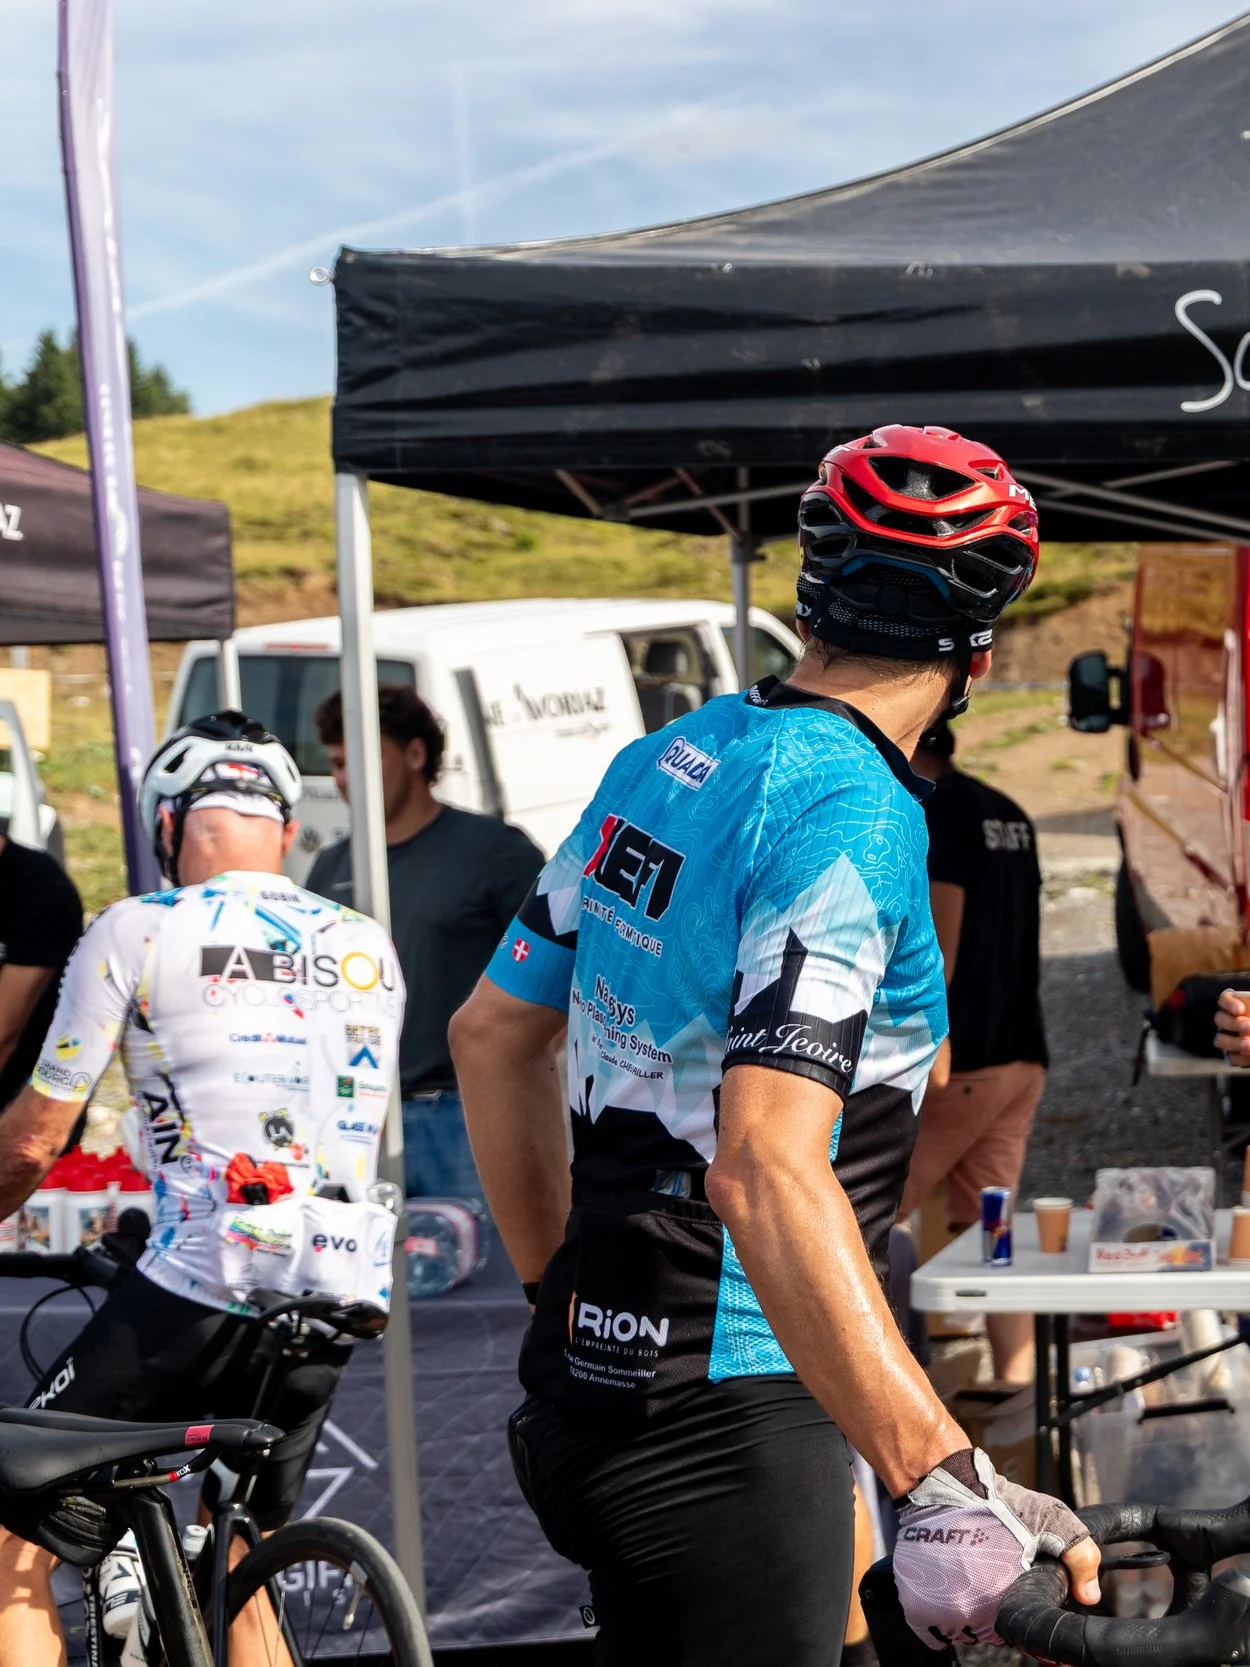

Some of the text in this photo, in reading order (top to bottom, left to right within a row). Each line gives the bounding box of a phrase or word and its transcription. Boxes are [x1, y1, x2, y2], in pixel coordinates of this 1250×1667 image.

[629, 1034, 672, 1064] System
[758, 1023, 853, 1074] Jeoire
[142, 1091, 181, 1165] AIN
[311, 1233, 358, 1253] evo
[637, 1349, 659, 1358] BOIS
[607, 1364, 657, 1379] Sommeiller
[588, 1374, 636, 1389] Annemasse
[903, 1527, 970, 1545] CRAFT
